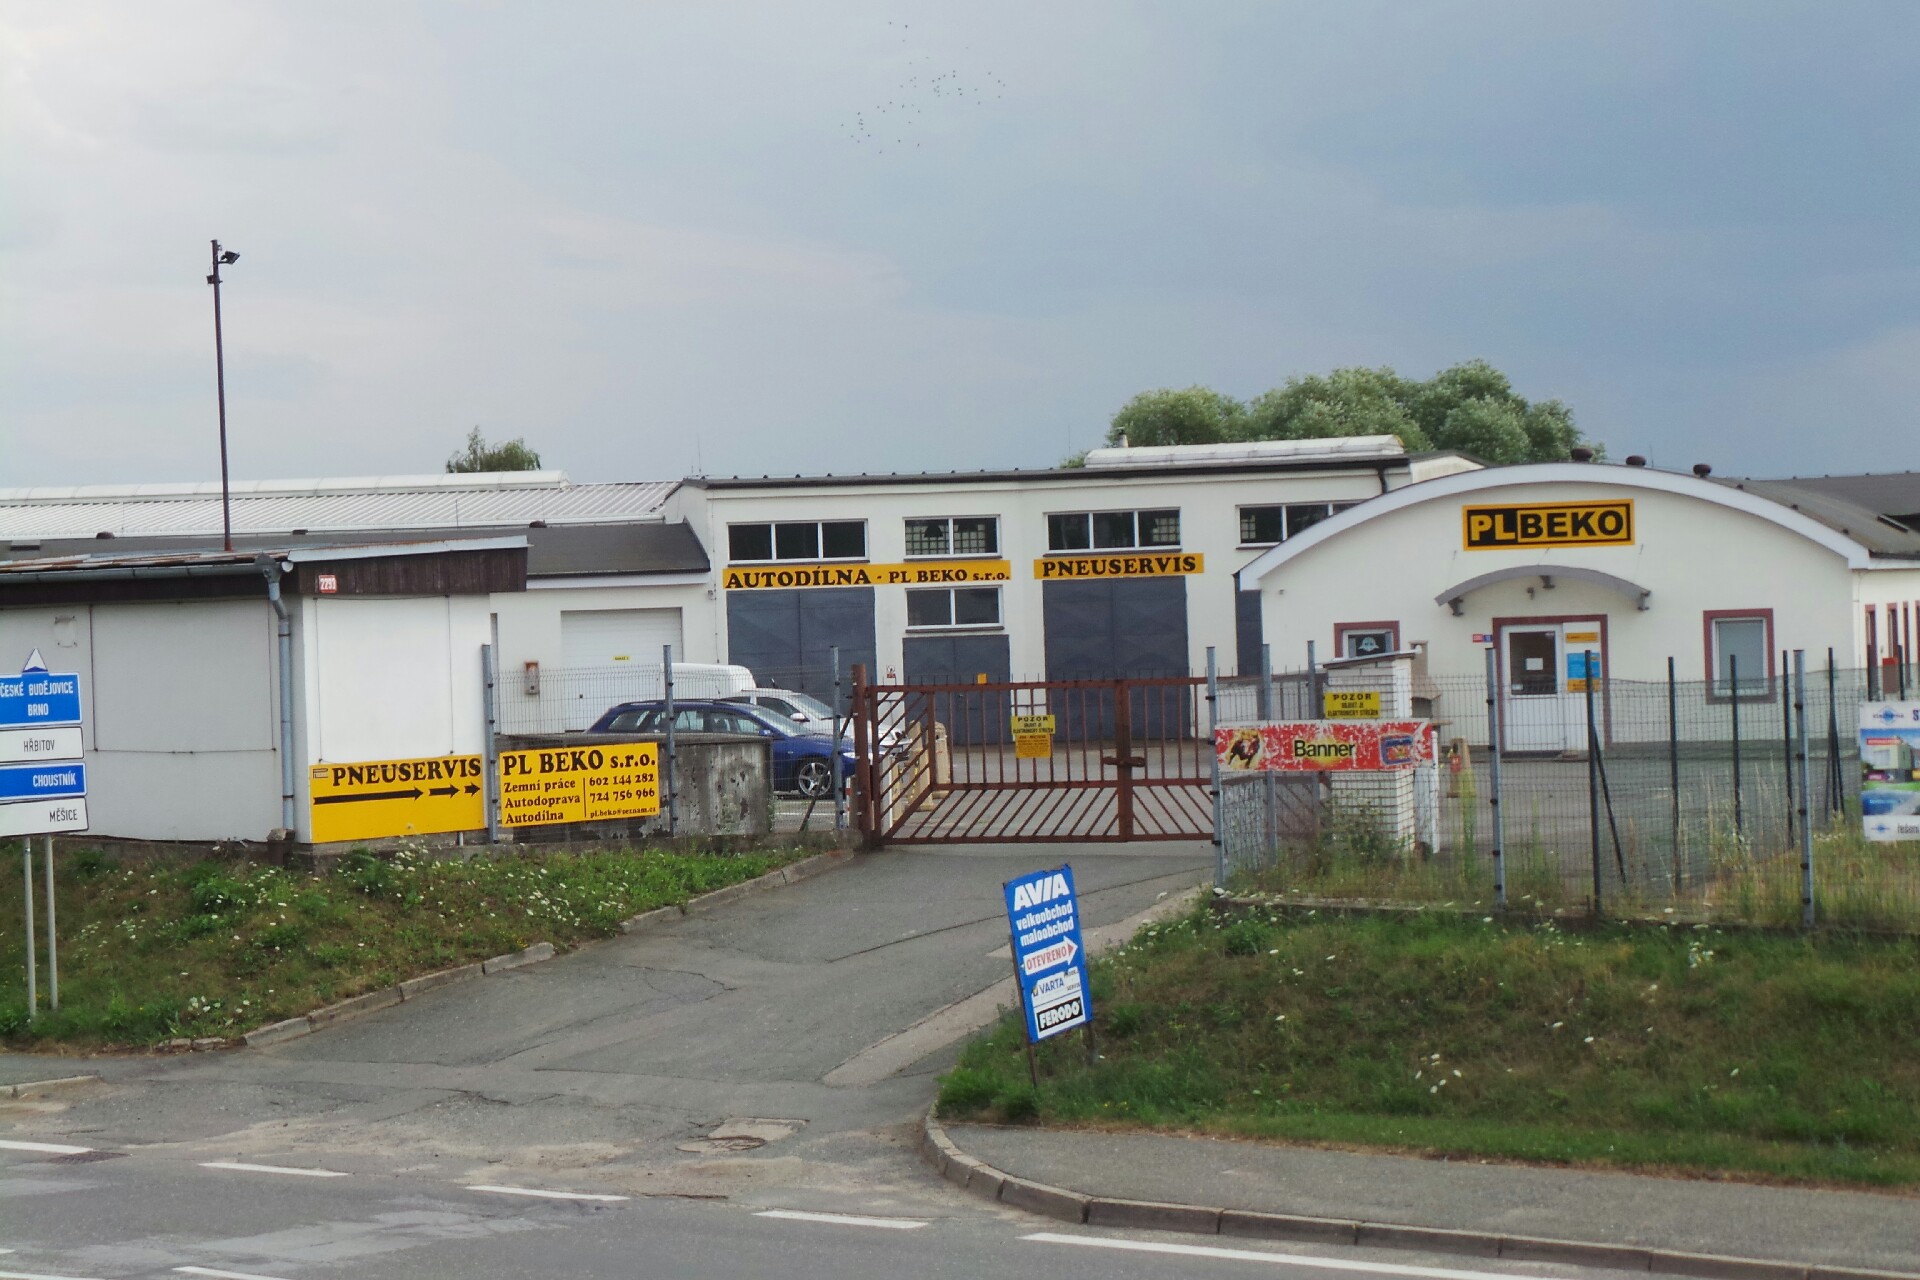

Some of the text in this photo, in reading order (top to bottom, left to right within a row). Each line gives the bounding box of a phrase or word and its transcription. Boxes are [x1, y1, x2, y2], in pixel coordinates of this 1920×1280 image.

[1042, 556, 1196, 577] PNEUSERVIS
[725, 566, 871, 588] AUTODÍLNA
[889, 571, 911, 583] PL
[917, 569, 968, 582] BEKO
[972, 572, 1010, 580] s.r.o.
[0, 680, 73, 697] ČESKÉ BUDĚJOVICE
[27, 703, 49, 716] BRNO
[23, 739, 55, 752] HŘBITOV
[1294, 739, 1356, 758] Banner
[503, 750, 656, 775] PL BEKO s.r.o.
[32, 771, 77, 787] CHOUSTNÍK
[332, 758, 481, 786] PNEUSERVIS
[589, 773, 655, 786] 602 144 282
[504, 778, 576, 793] Zemní práce
[505, 795, 580, 808] Autodoprava
[590, 788, 655, 803] 724 756 966
[49, 808, 78, 822] MĚŠICE
[505, 810, 564, 824] Autodílna
[1014, 874, 1070, 911] AVIA
[1016, 900, 1073, 931] velkoobchod
[1020, 915, 1075, 947] maloobchod
[1038, 977, 1065, 995] VARTA
[1039, 1001, 1081, 1030] FERODO
